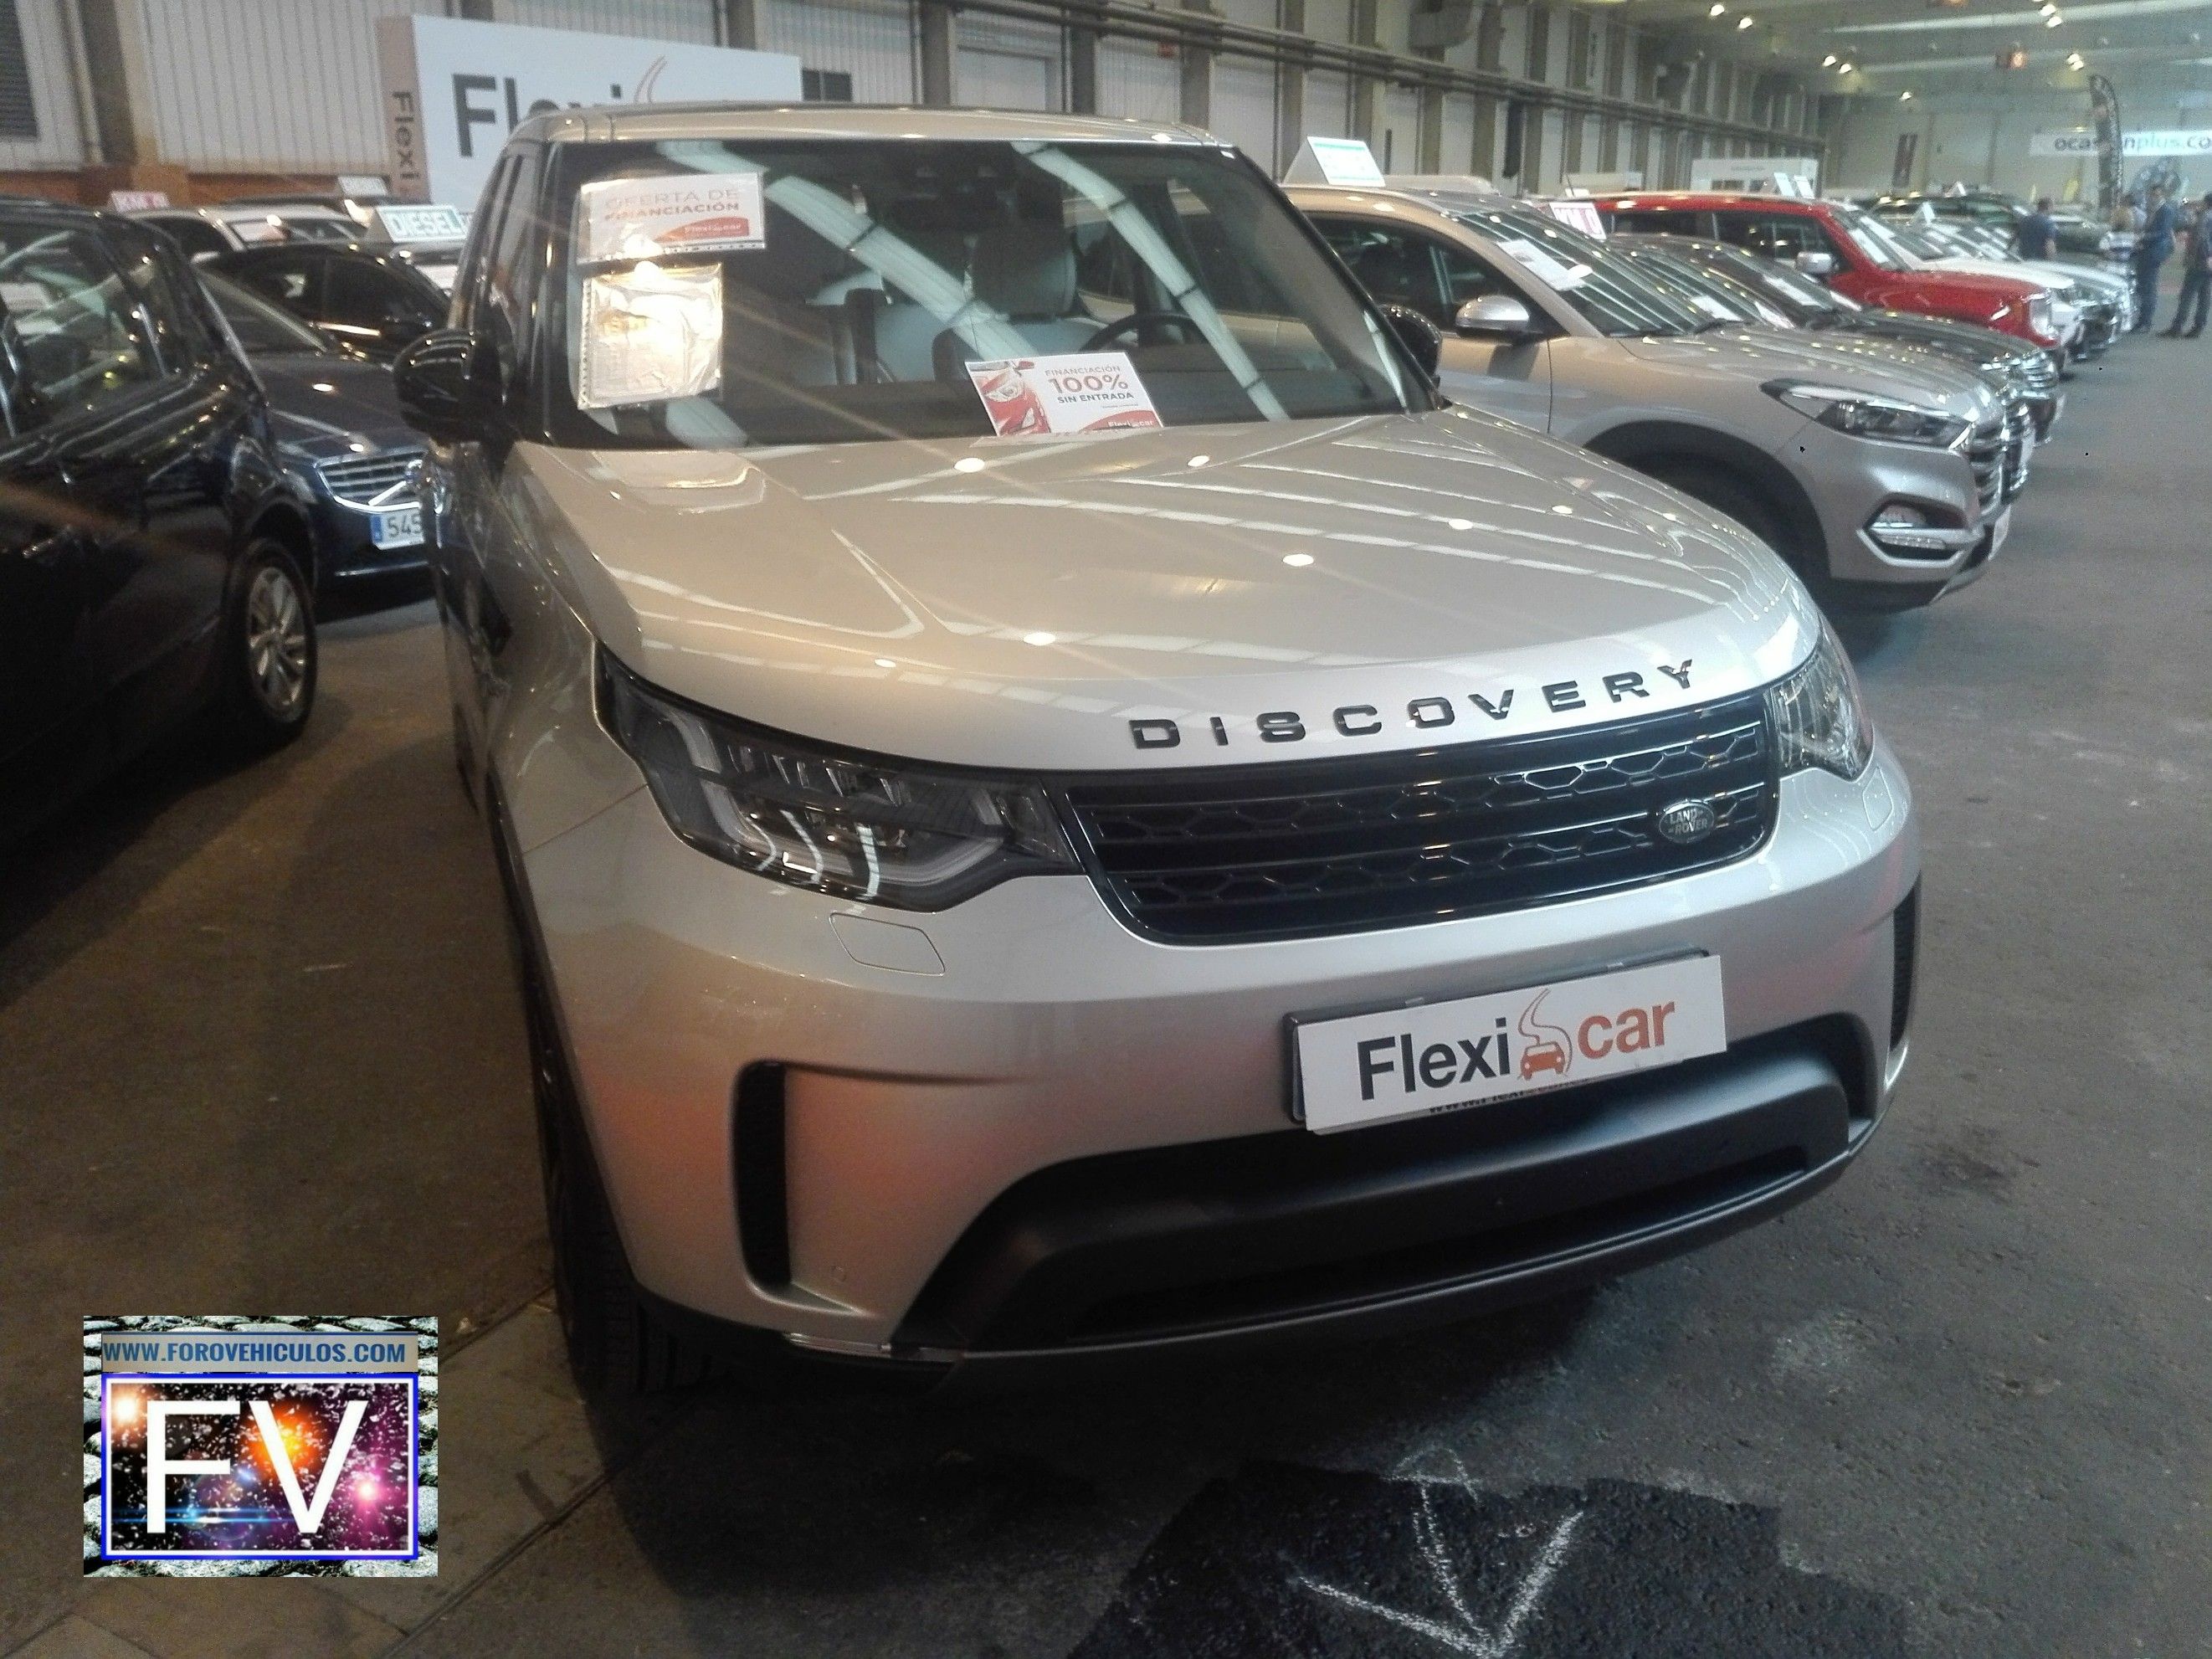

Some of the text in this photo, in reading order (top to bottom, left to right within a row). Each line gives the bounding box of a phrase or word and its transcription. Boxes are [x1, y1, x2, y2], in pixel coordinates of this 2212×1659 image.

[393, 90, 420, 181] Flexi
[708, 188, 739, 202] DE
[1044, 365, 1121, 377] FINANCIACIÓN
[1048, 373, 1129, 394] 100%
[1057, 392, 1135, 404] SIN ENTRADA
[1128, 659, 1693, 749] DISCOVERY
[1670, 807, 1697, 824] LAND
[1675, 818, 1708, 835] ROVER
[1357, 1016, 1510, 1102] Flexi
[1577, 1000, 1676, 1061] car
